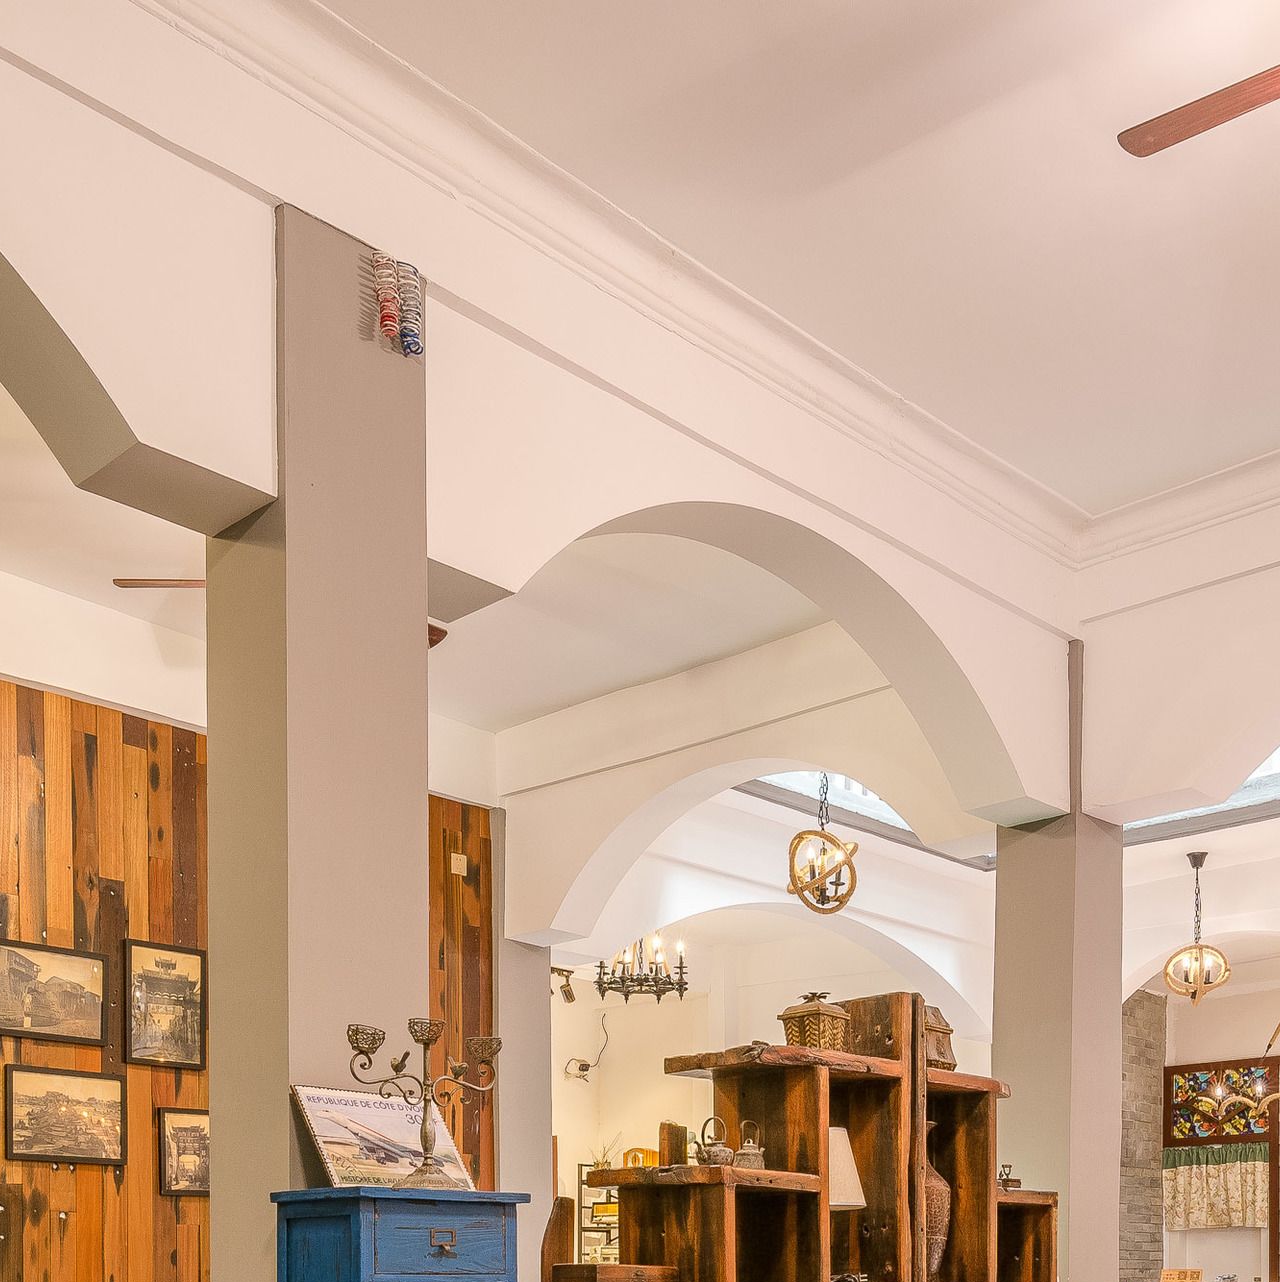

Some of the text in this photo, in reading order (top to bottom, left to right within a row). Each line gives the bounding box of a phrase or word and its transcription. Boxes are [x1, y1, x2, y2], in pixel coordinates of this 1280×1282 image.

[361, 1101, 371, 1109] DE
[398, 1103, 424, 1113] D'IVOI
[340, 1175, 372, 1184] HISTOIRE
[373, 1176, 382, 1184] DE
